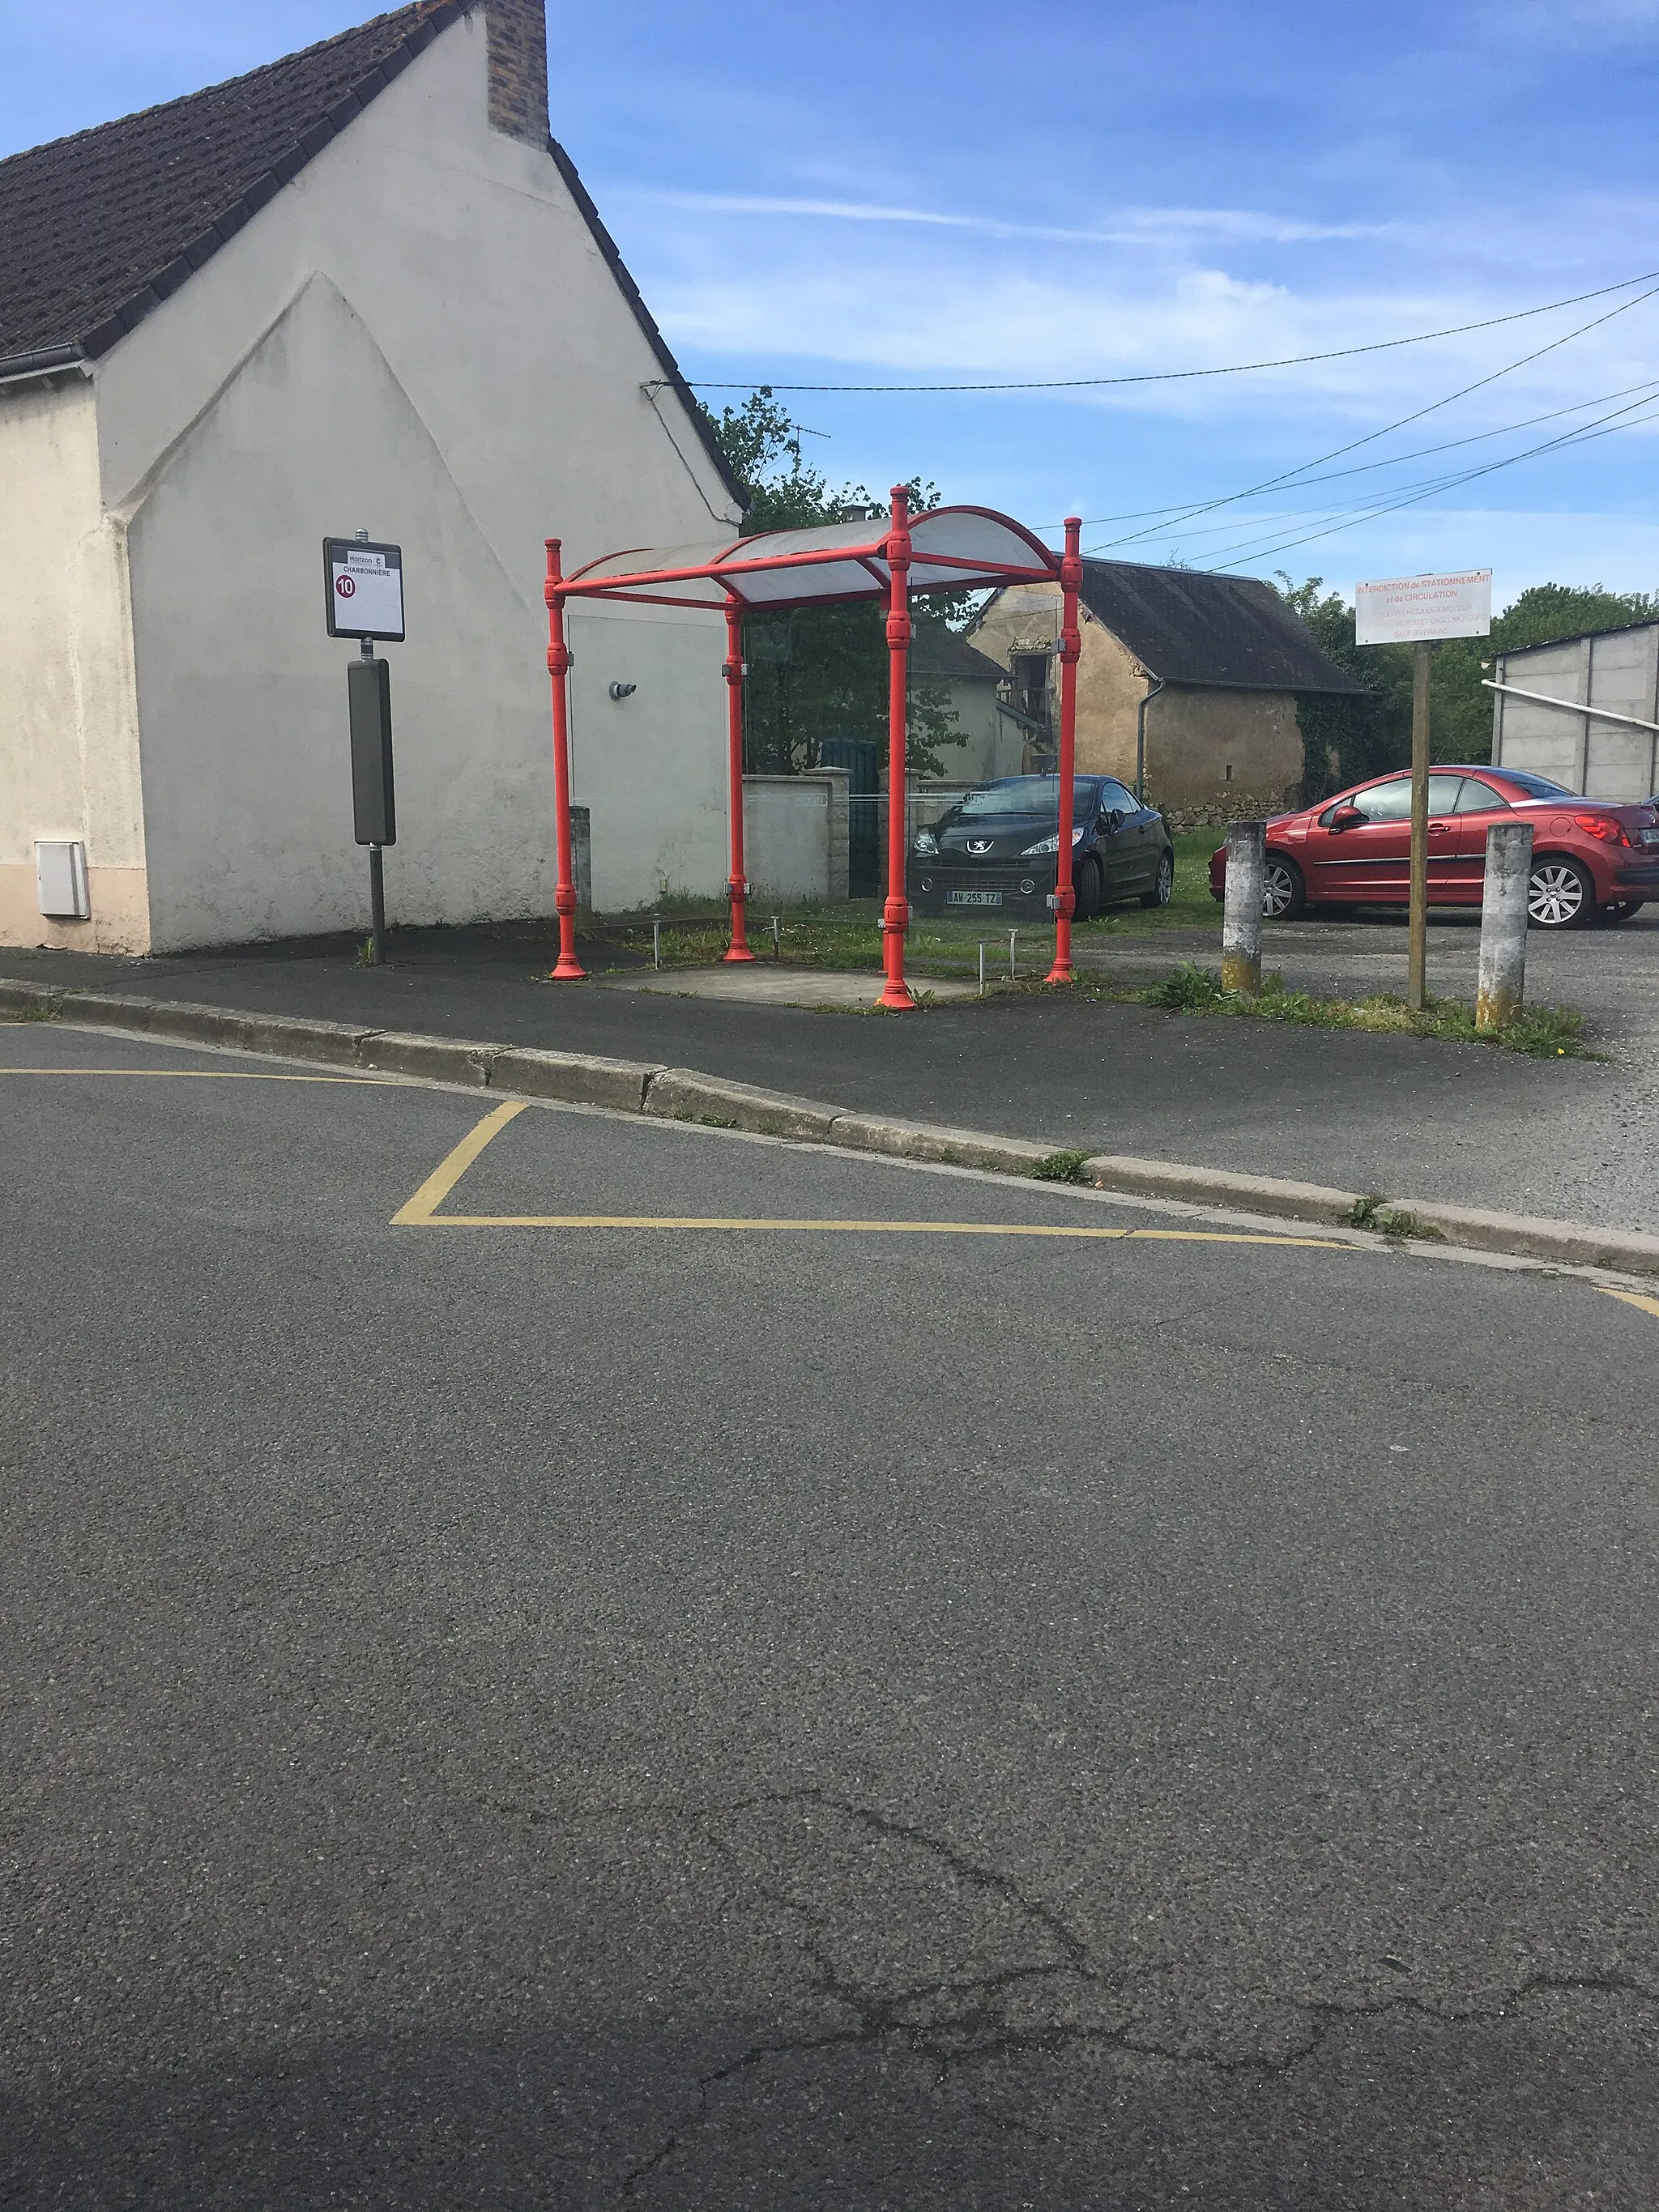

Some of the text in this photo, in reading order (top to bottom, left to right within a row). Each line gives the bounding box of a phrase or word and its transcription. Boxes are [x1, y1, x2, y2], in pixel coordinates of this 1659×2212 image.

[338, 578, 353, 594] 10
[1357, 582, 1410, 594] INTERDICTION
[1421, 574, 1491, 588] STATIONNEMENT
[1405, 590, 1457, 602] CIRCULATION
[1442, 603, 1473, 613] MOTEUR
[1396, 619, 1419, 628] MOTOS
[1430, 613, 1487, 624] CYCLOMOTEURS
[1413, 628, 1449, 637] RIVERAINS
